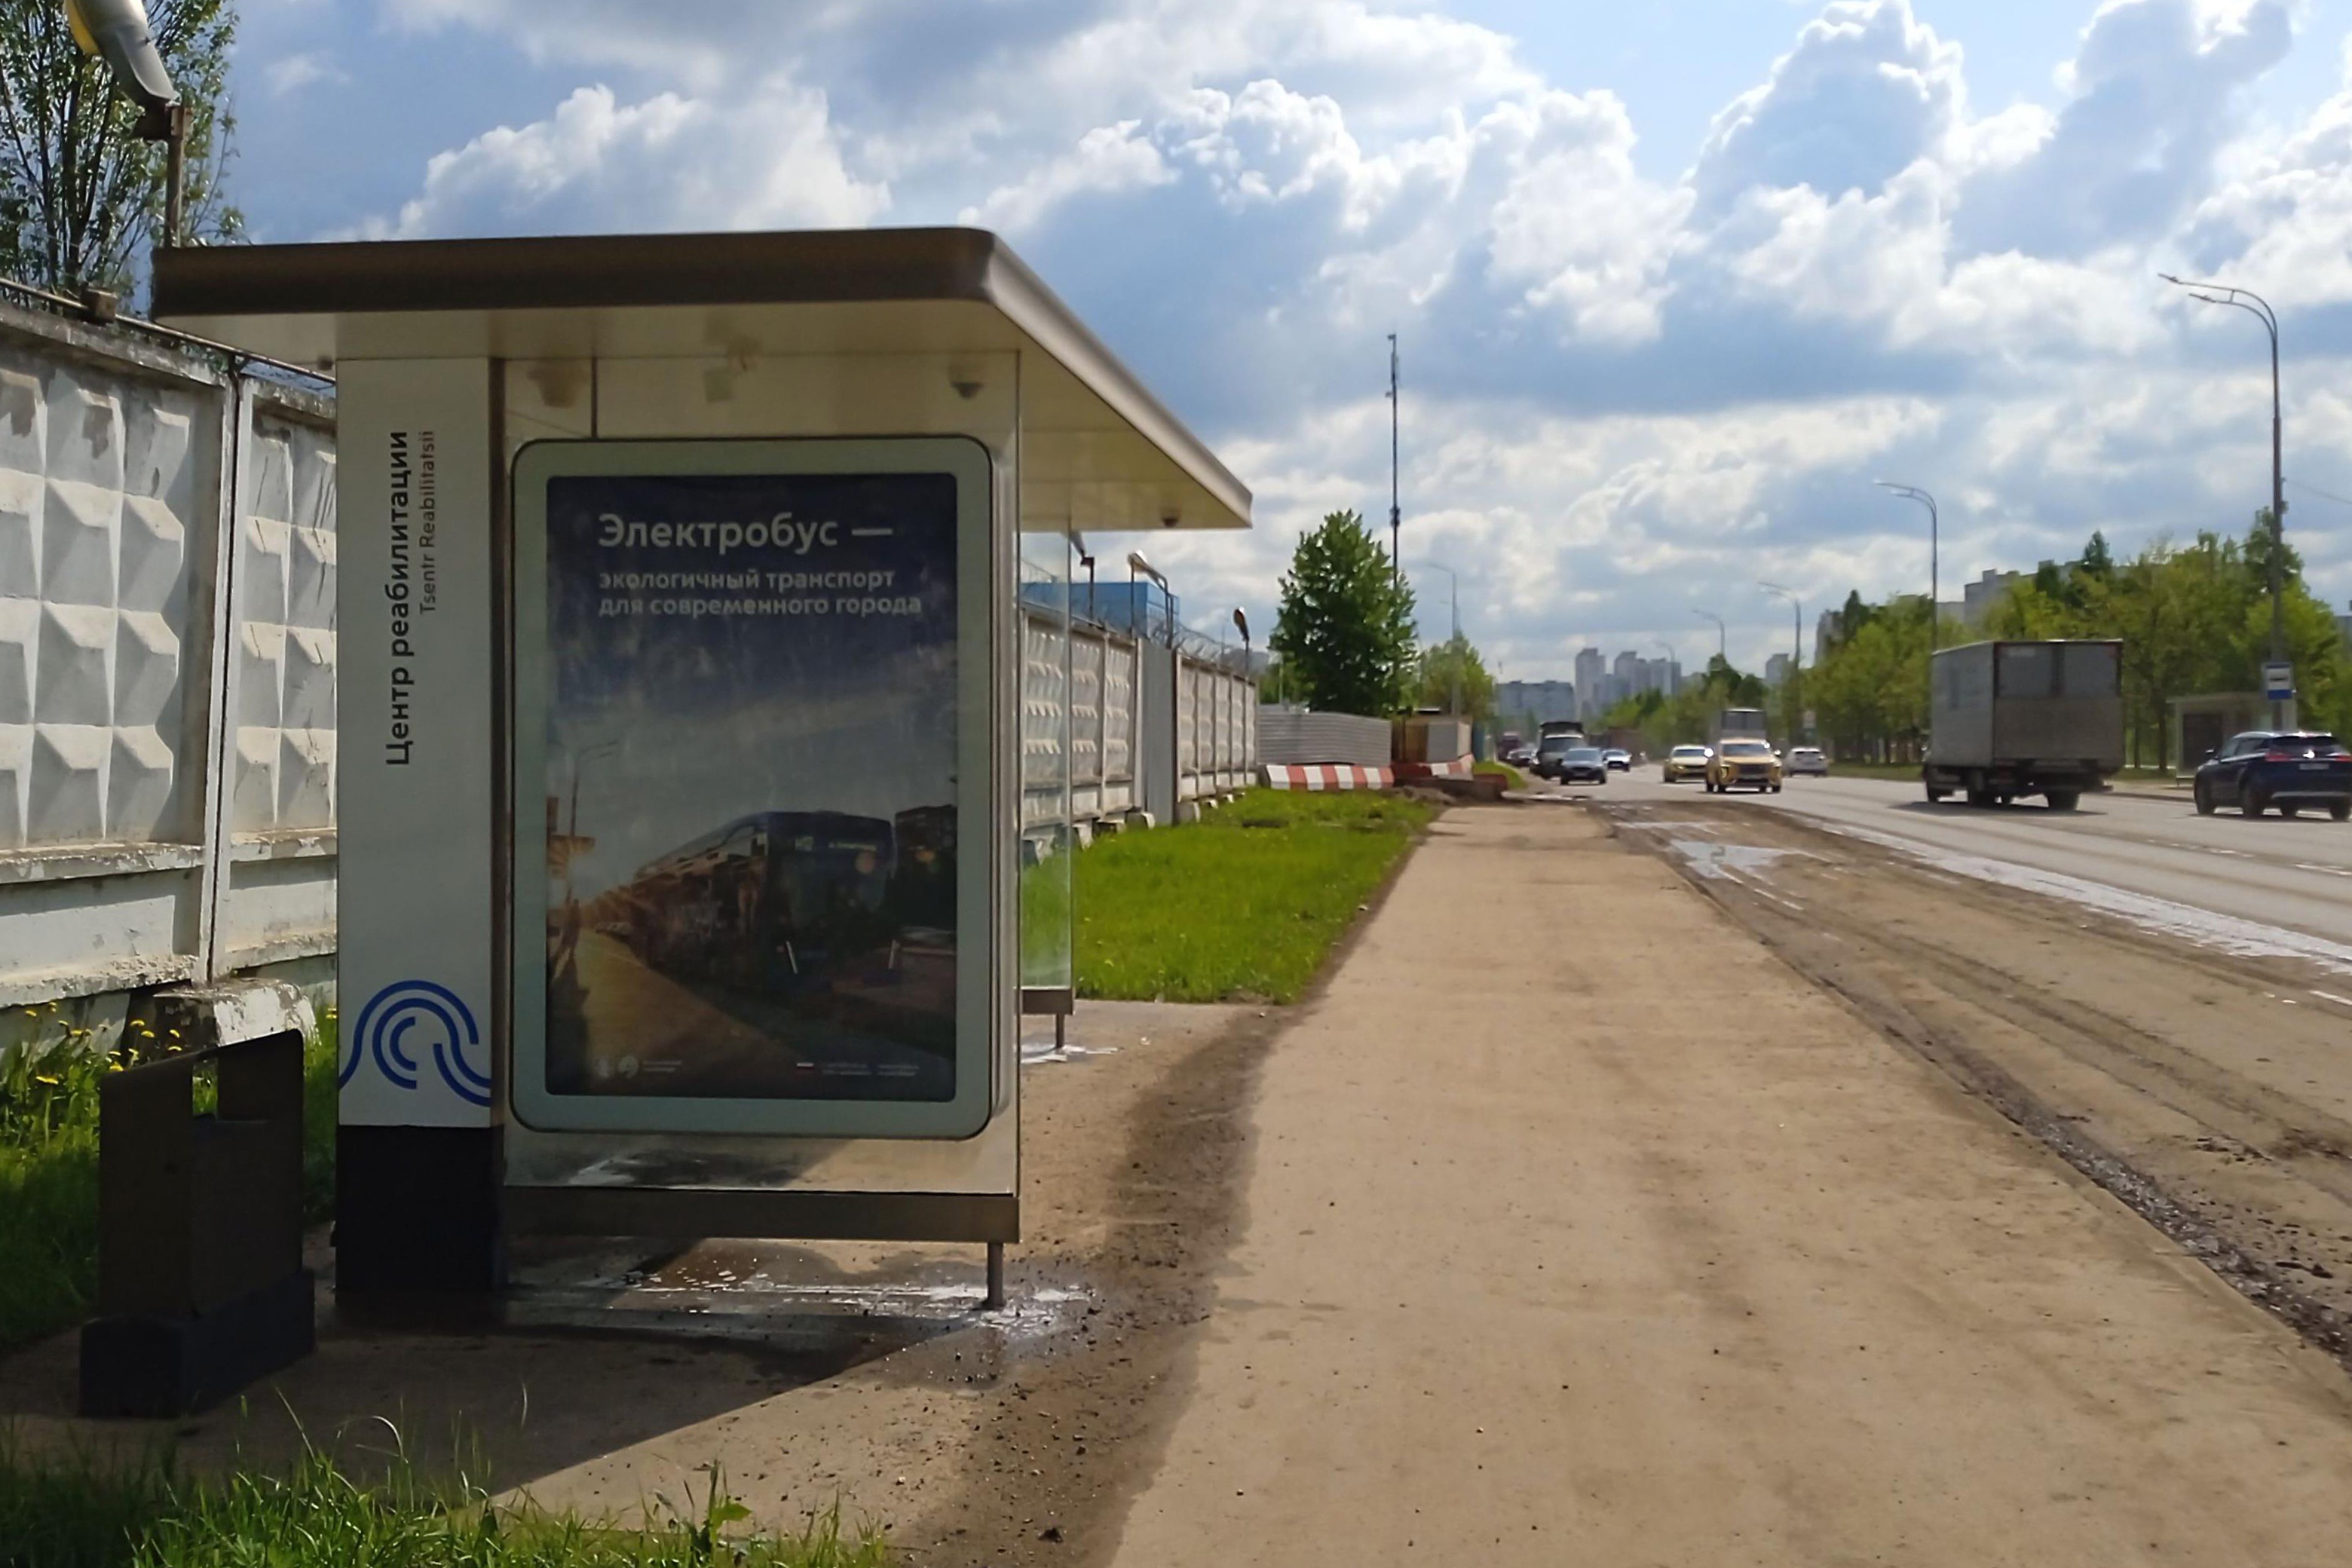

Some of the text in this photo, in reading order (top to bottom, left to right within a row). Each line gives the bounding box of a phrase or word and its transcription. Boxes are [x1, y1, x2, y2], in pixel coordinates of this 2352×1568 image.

[419, 430, 436, 614] Tsentr Reabilitatsii
[599, 513, 838, 554] Электробус
[385, 433, 415, 765] Центр реабилитации
[599, 569, 895, 593] экологичный транспорт
[598, 595, 922, 617] для современного города
